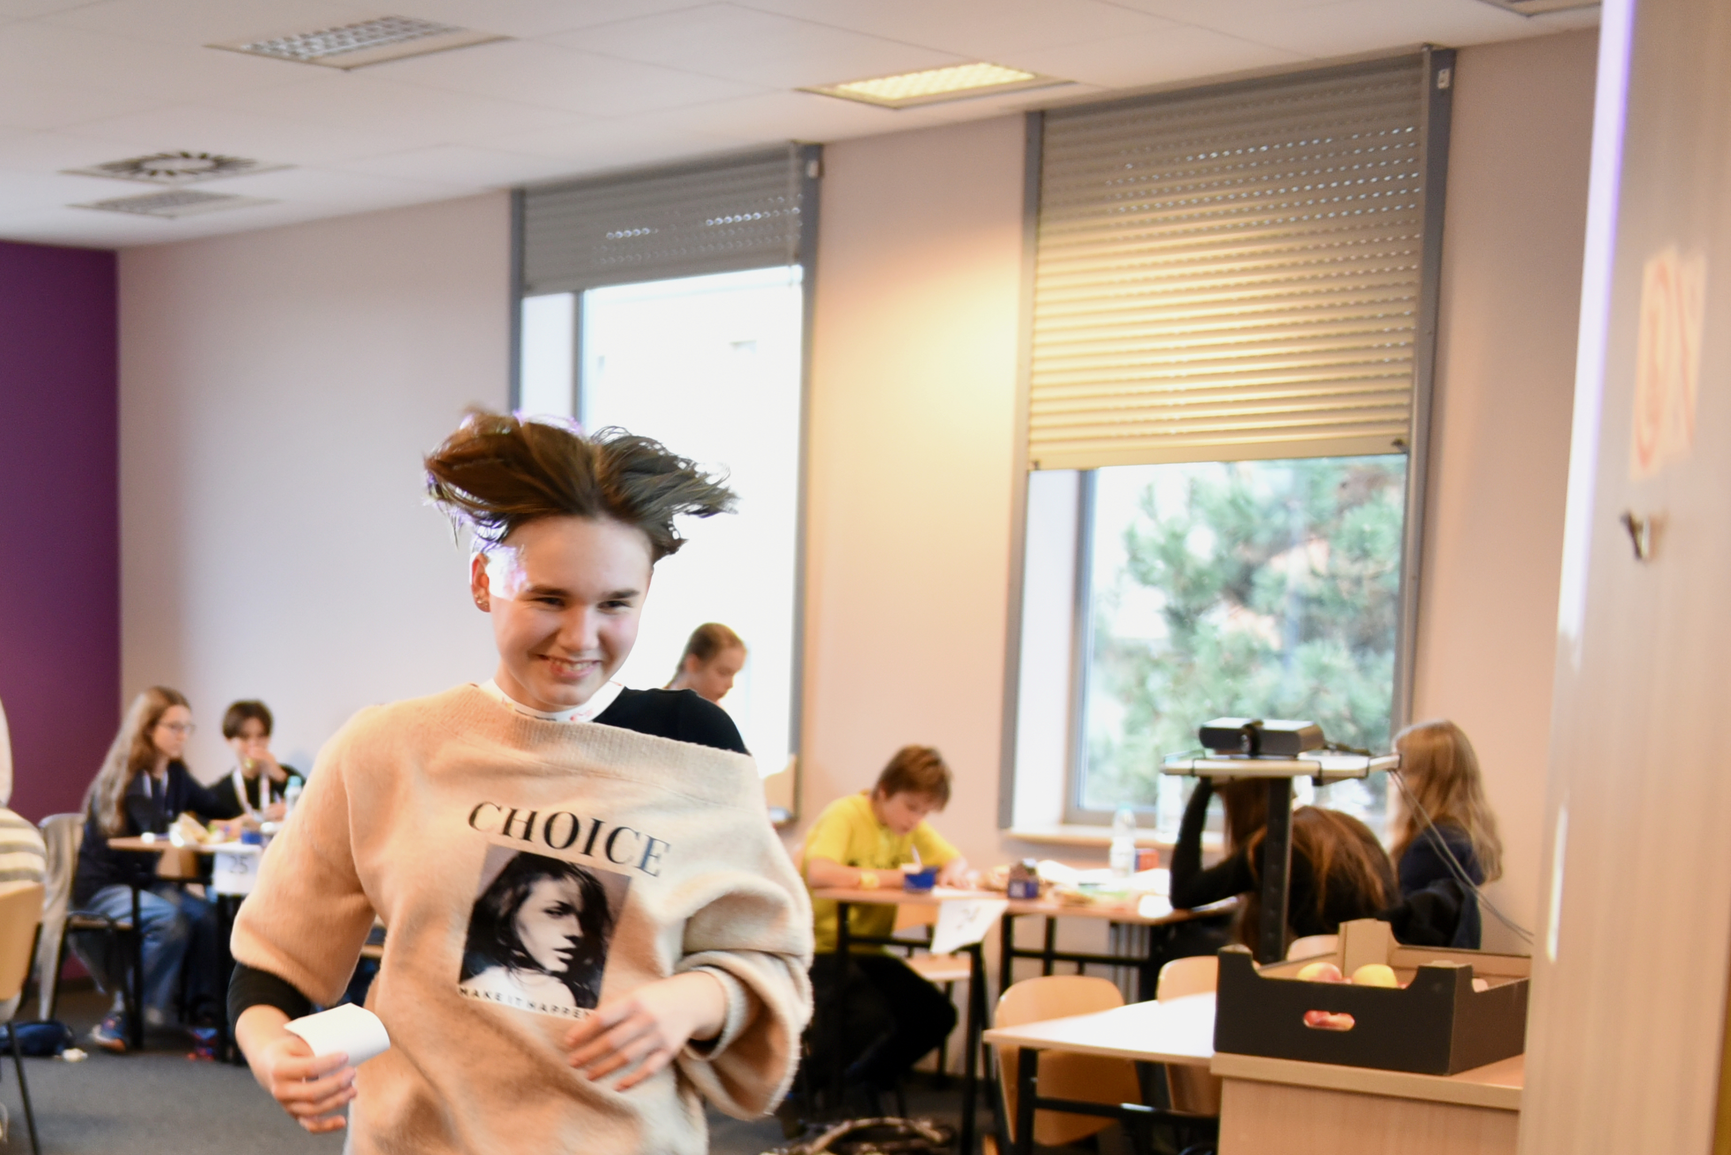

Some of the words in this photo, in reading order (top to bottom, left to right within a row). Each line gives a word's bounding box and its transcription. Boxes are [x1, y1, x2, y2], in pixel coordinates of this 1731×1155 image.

[468, 802, 670, 878] CHOICE
[459, 986, 502, 1002] MAKE
[509, 995, 523, 1006] IT
